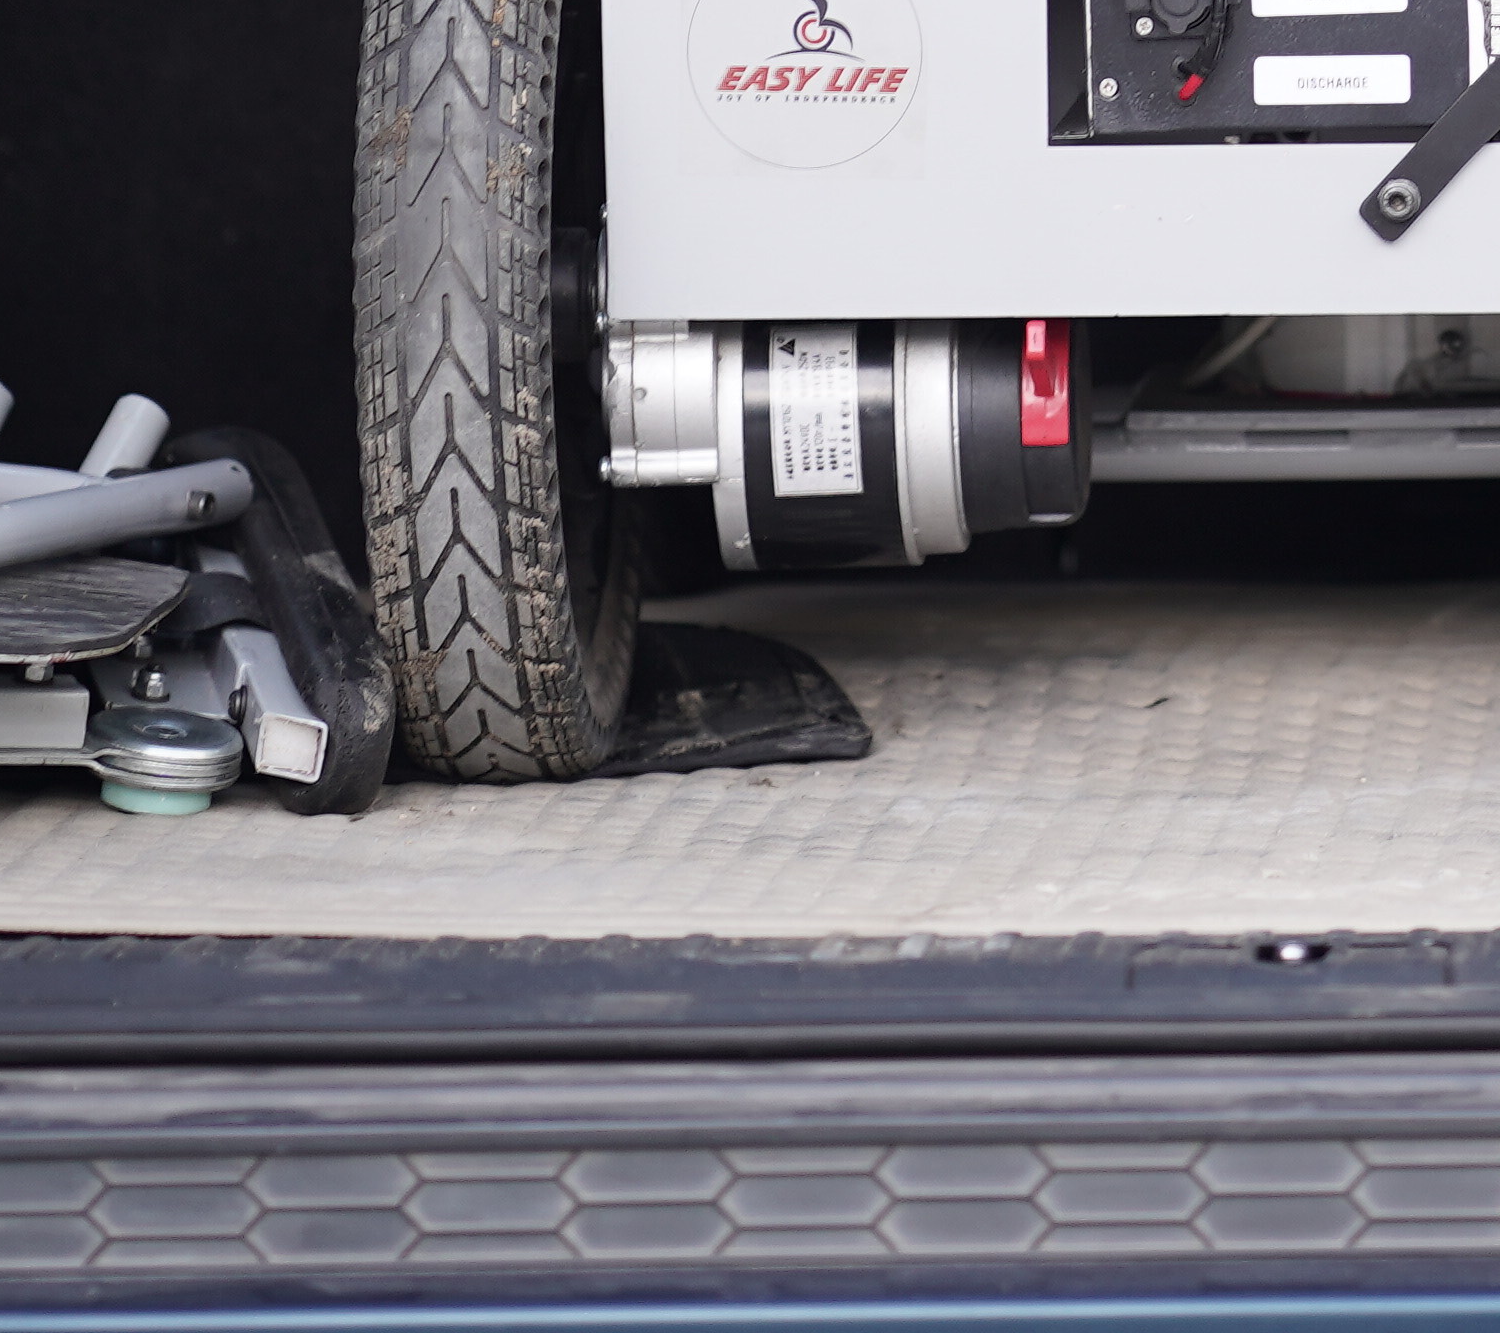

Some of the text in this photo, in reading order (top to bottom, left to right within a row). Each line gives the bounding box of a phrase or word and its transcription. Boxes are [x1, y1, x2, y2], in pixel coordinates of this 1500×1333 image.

[717, 65, 910, 93] EASY LIFE
[1297, 76, 1369, 89] DISCHARGE
